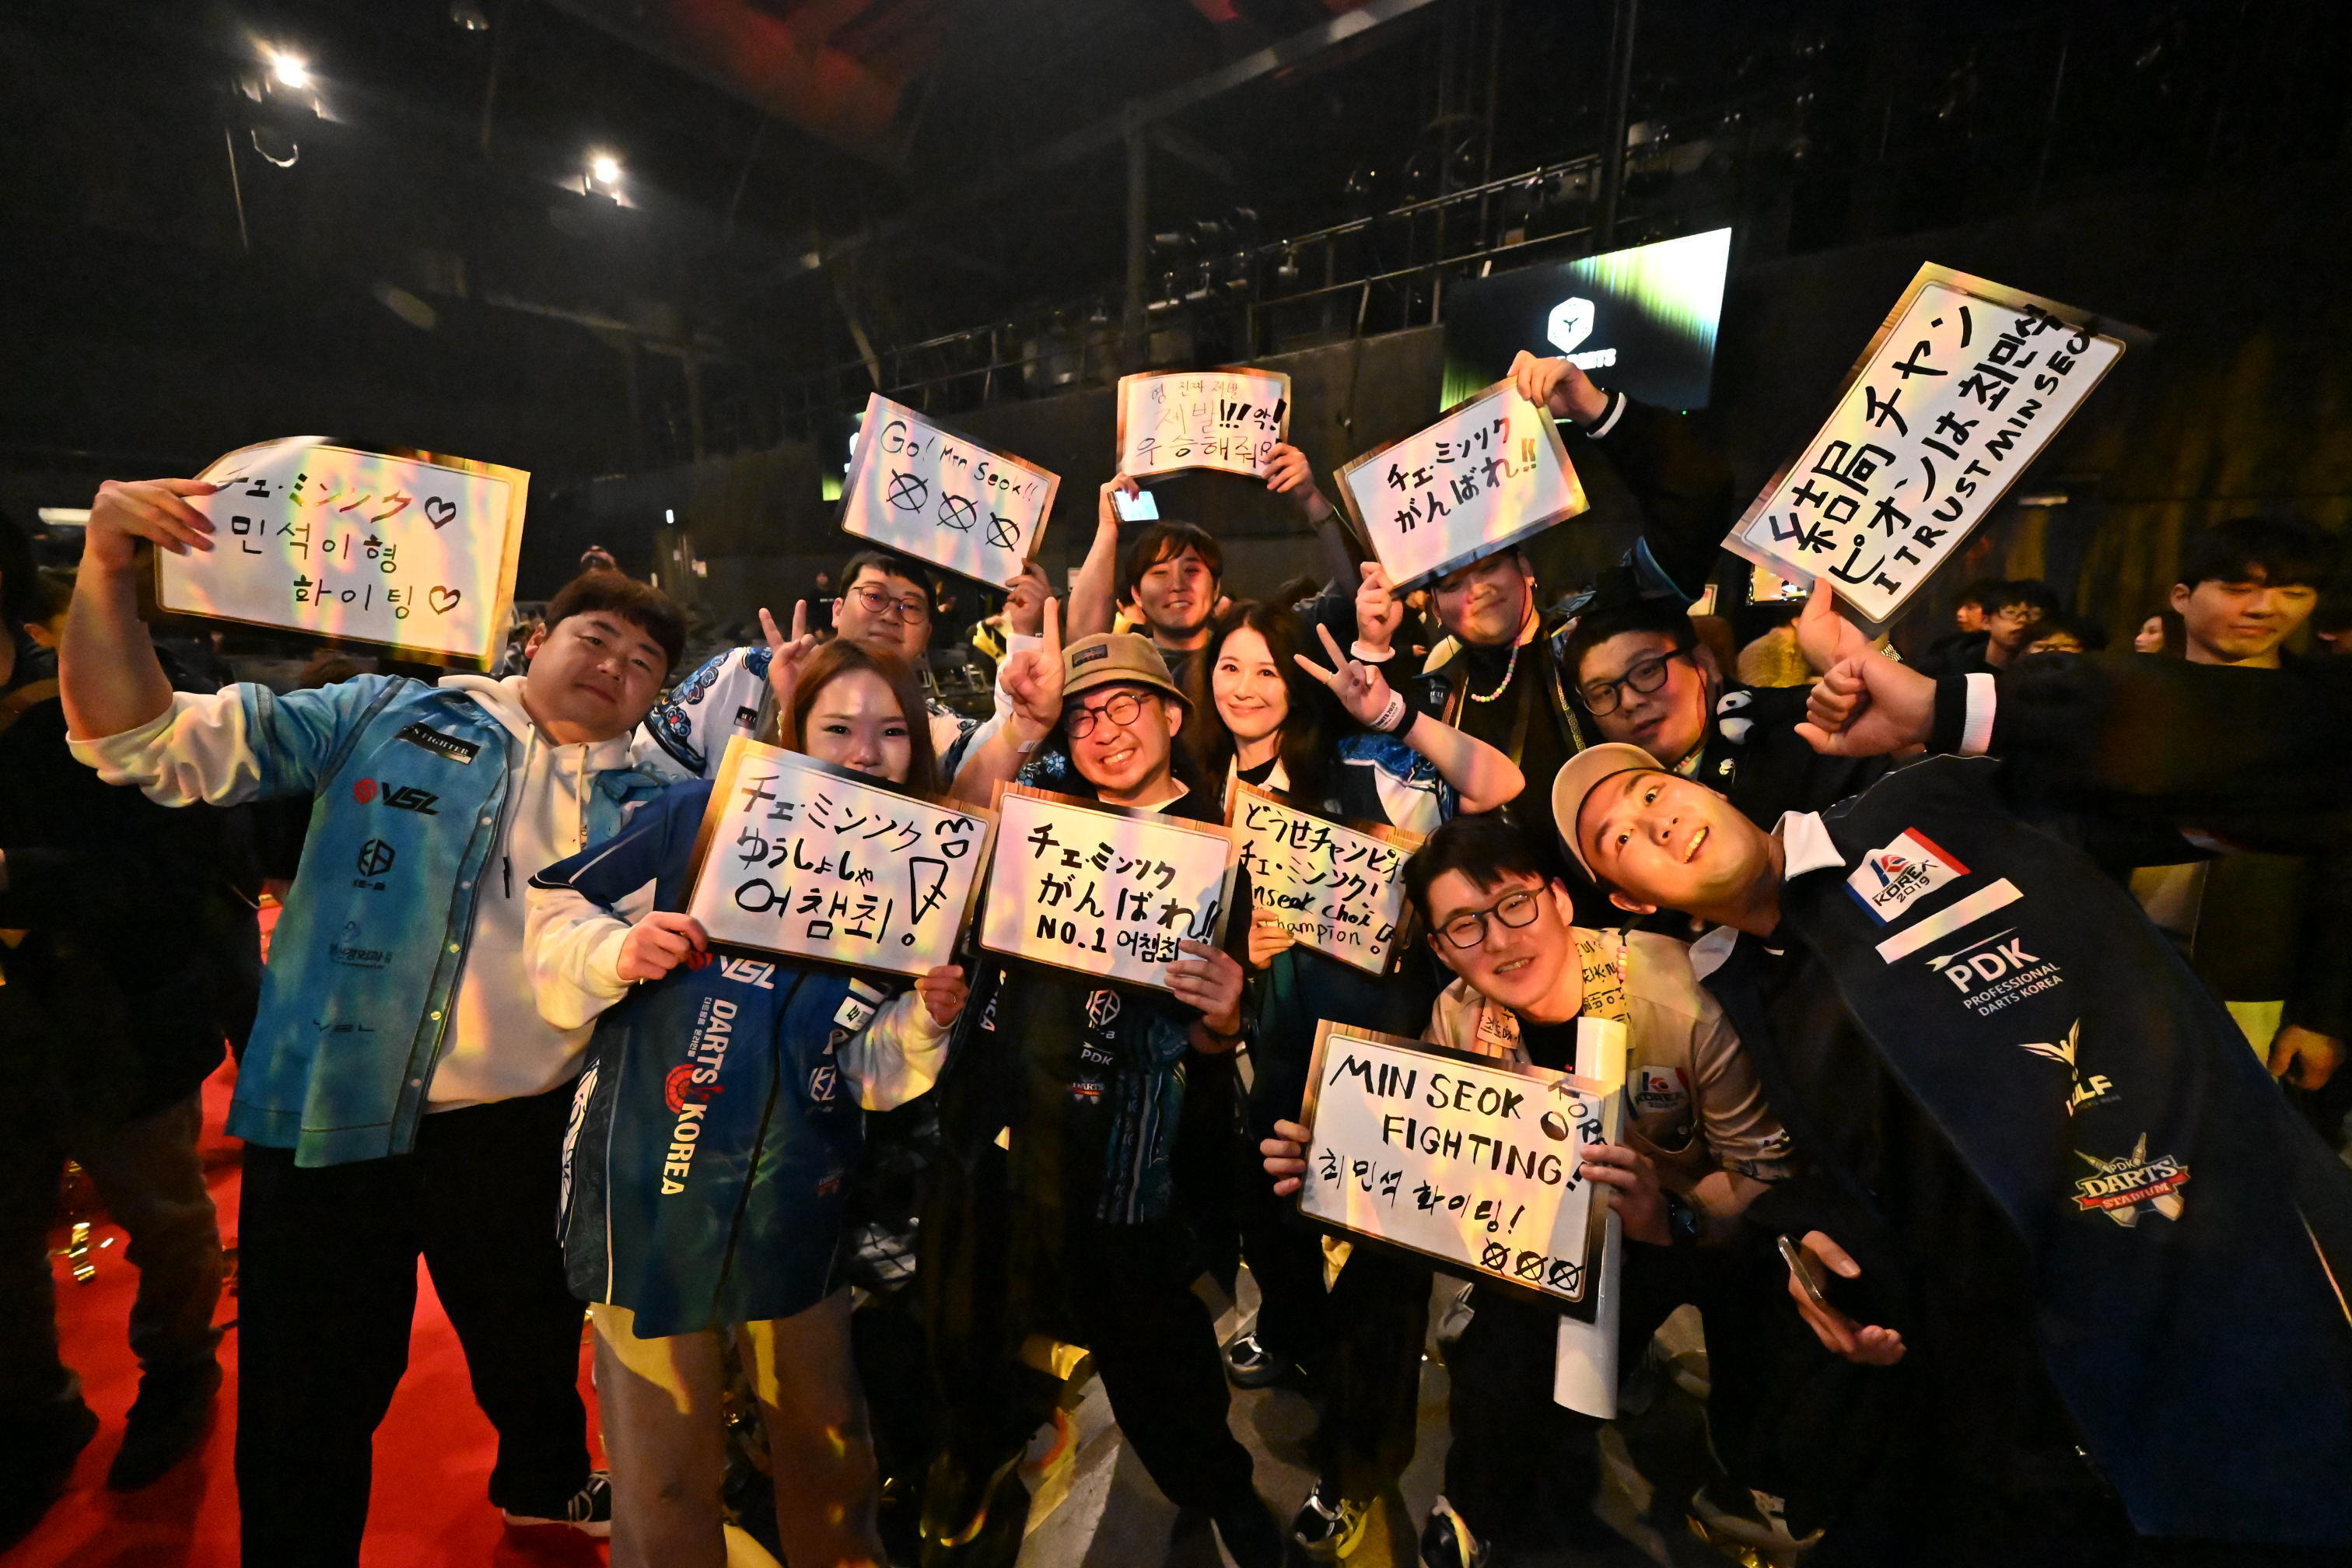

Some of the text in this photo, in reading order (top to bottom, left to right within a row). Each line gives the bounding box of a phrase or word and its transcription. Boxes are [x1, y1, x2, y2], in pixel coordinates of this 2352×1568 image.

[880, 421, 935, 461] Go!
[1136, 434, 1283, 468] 우승해줘요
[1769, 305, 1973, 554] 結局チャン
[1873, 571, 1901, 595] I
[1895, 459, 1992, 566] TRUST
[1985, 398, 2042, 462] MIN
[231, 515, 398, 574] 민석이형
[292, 574, 414, 620] 화이팅
[1245, 803, 1405, 884] どうせチャンピオ
[1896, 876, 1930, 904] 2019
[1036, 914, 1107, 954] NO.1
[1944, 937, 2041, 994] PDK
[1962, 961, 2061, 1010] PROFESSIONAL
[1978, 974, 2064, 1017] DARTS KOREA
[1080, 1048, 1114, 1066] PDK
[660, 998, 738, 1195] DARTS KOREA
[1329, 1054, 1417, 1100] MIN
[1426, 1073, 1525, 1119] SEOK
[1318, 1148, 1404, 1209] 최민석
[2081, 1160, 2179, 1198] DARTS
[2109, 1160, 2134, 1174] PDK
[2102, 1181, 2169, 1208] STADIUM
